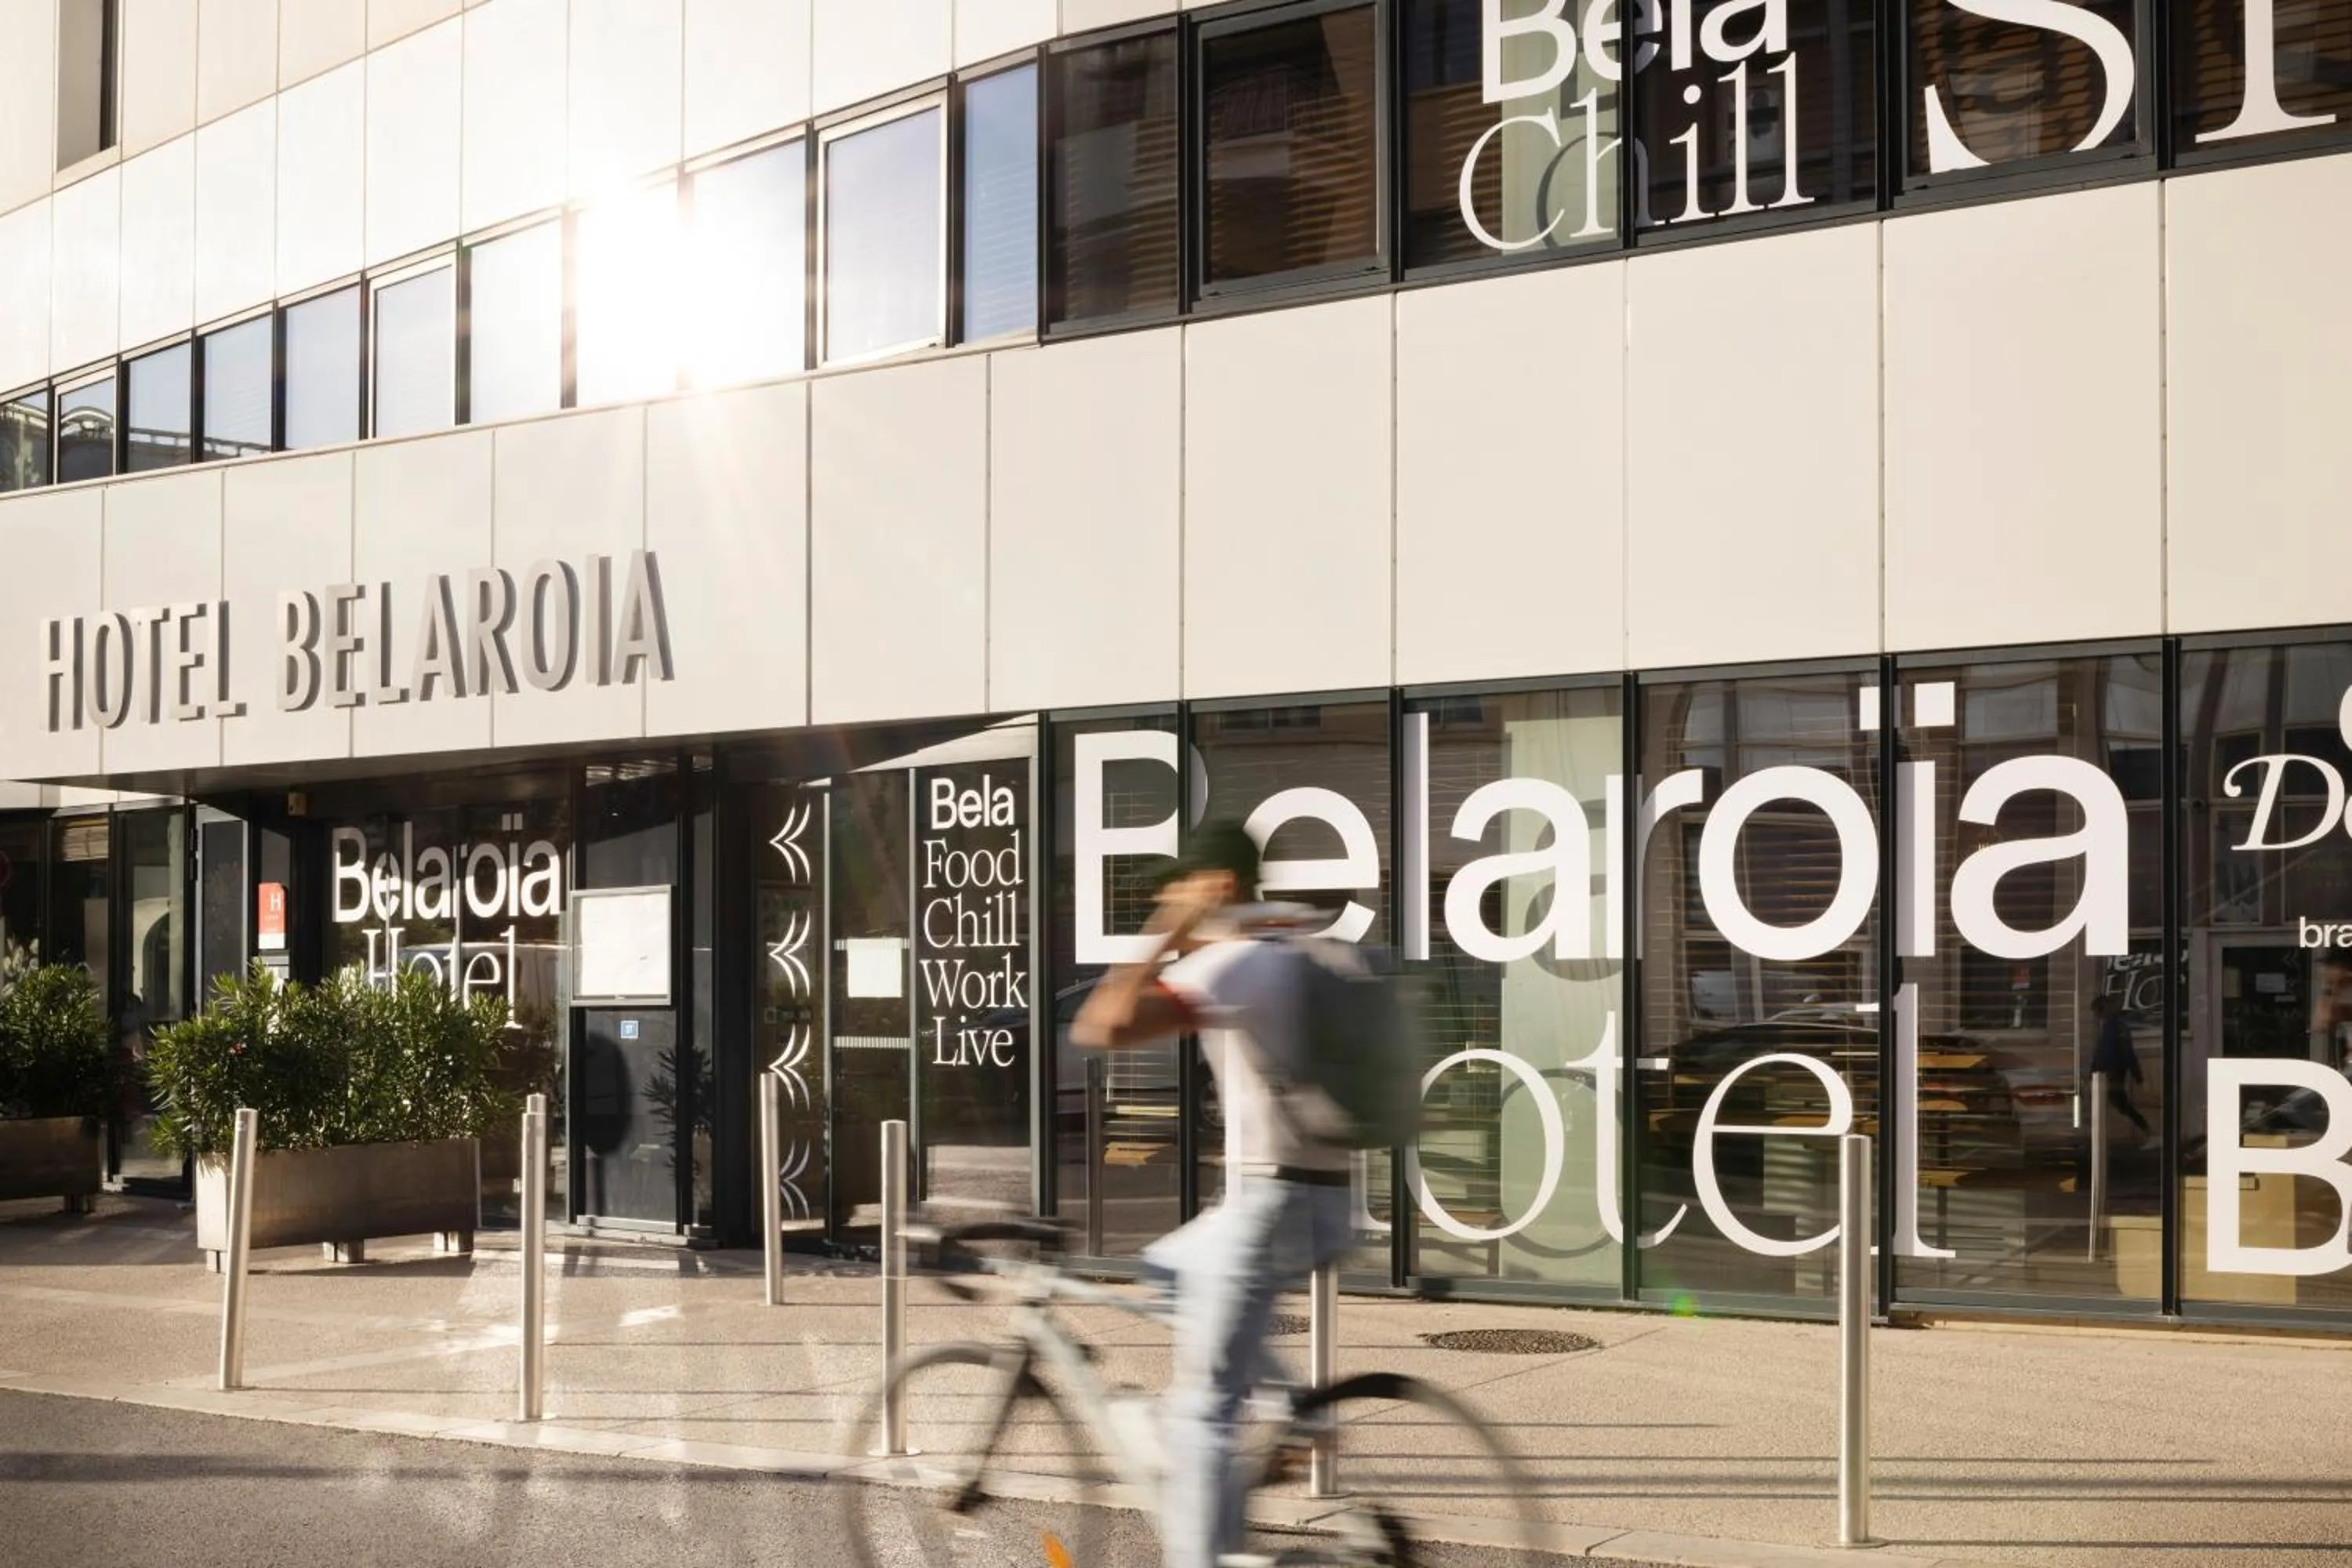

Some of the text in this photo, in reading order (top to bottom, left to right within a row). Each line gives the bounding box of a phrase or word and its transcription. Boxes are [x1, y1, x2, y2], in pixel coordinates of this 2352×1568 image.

[1459, 52, 1815, 250] Chill
[39, 550, 675, 732] HOTEL BELAROIA
[931, 775, 1016, 829] Bela
[923, 829, 1024, 888] Food
[923, 890, 1021, 949] Chill
[919, 951, 1029, 1009] Work
[931, 1015, 1015, 1068] Live
[1225, 982, 1956, 1258] otel
